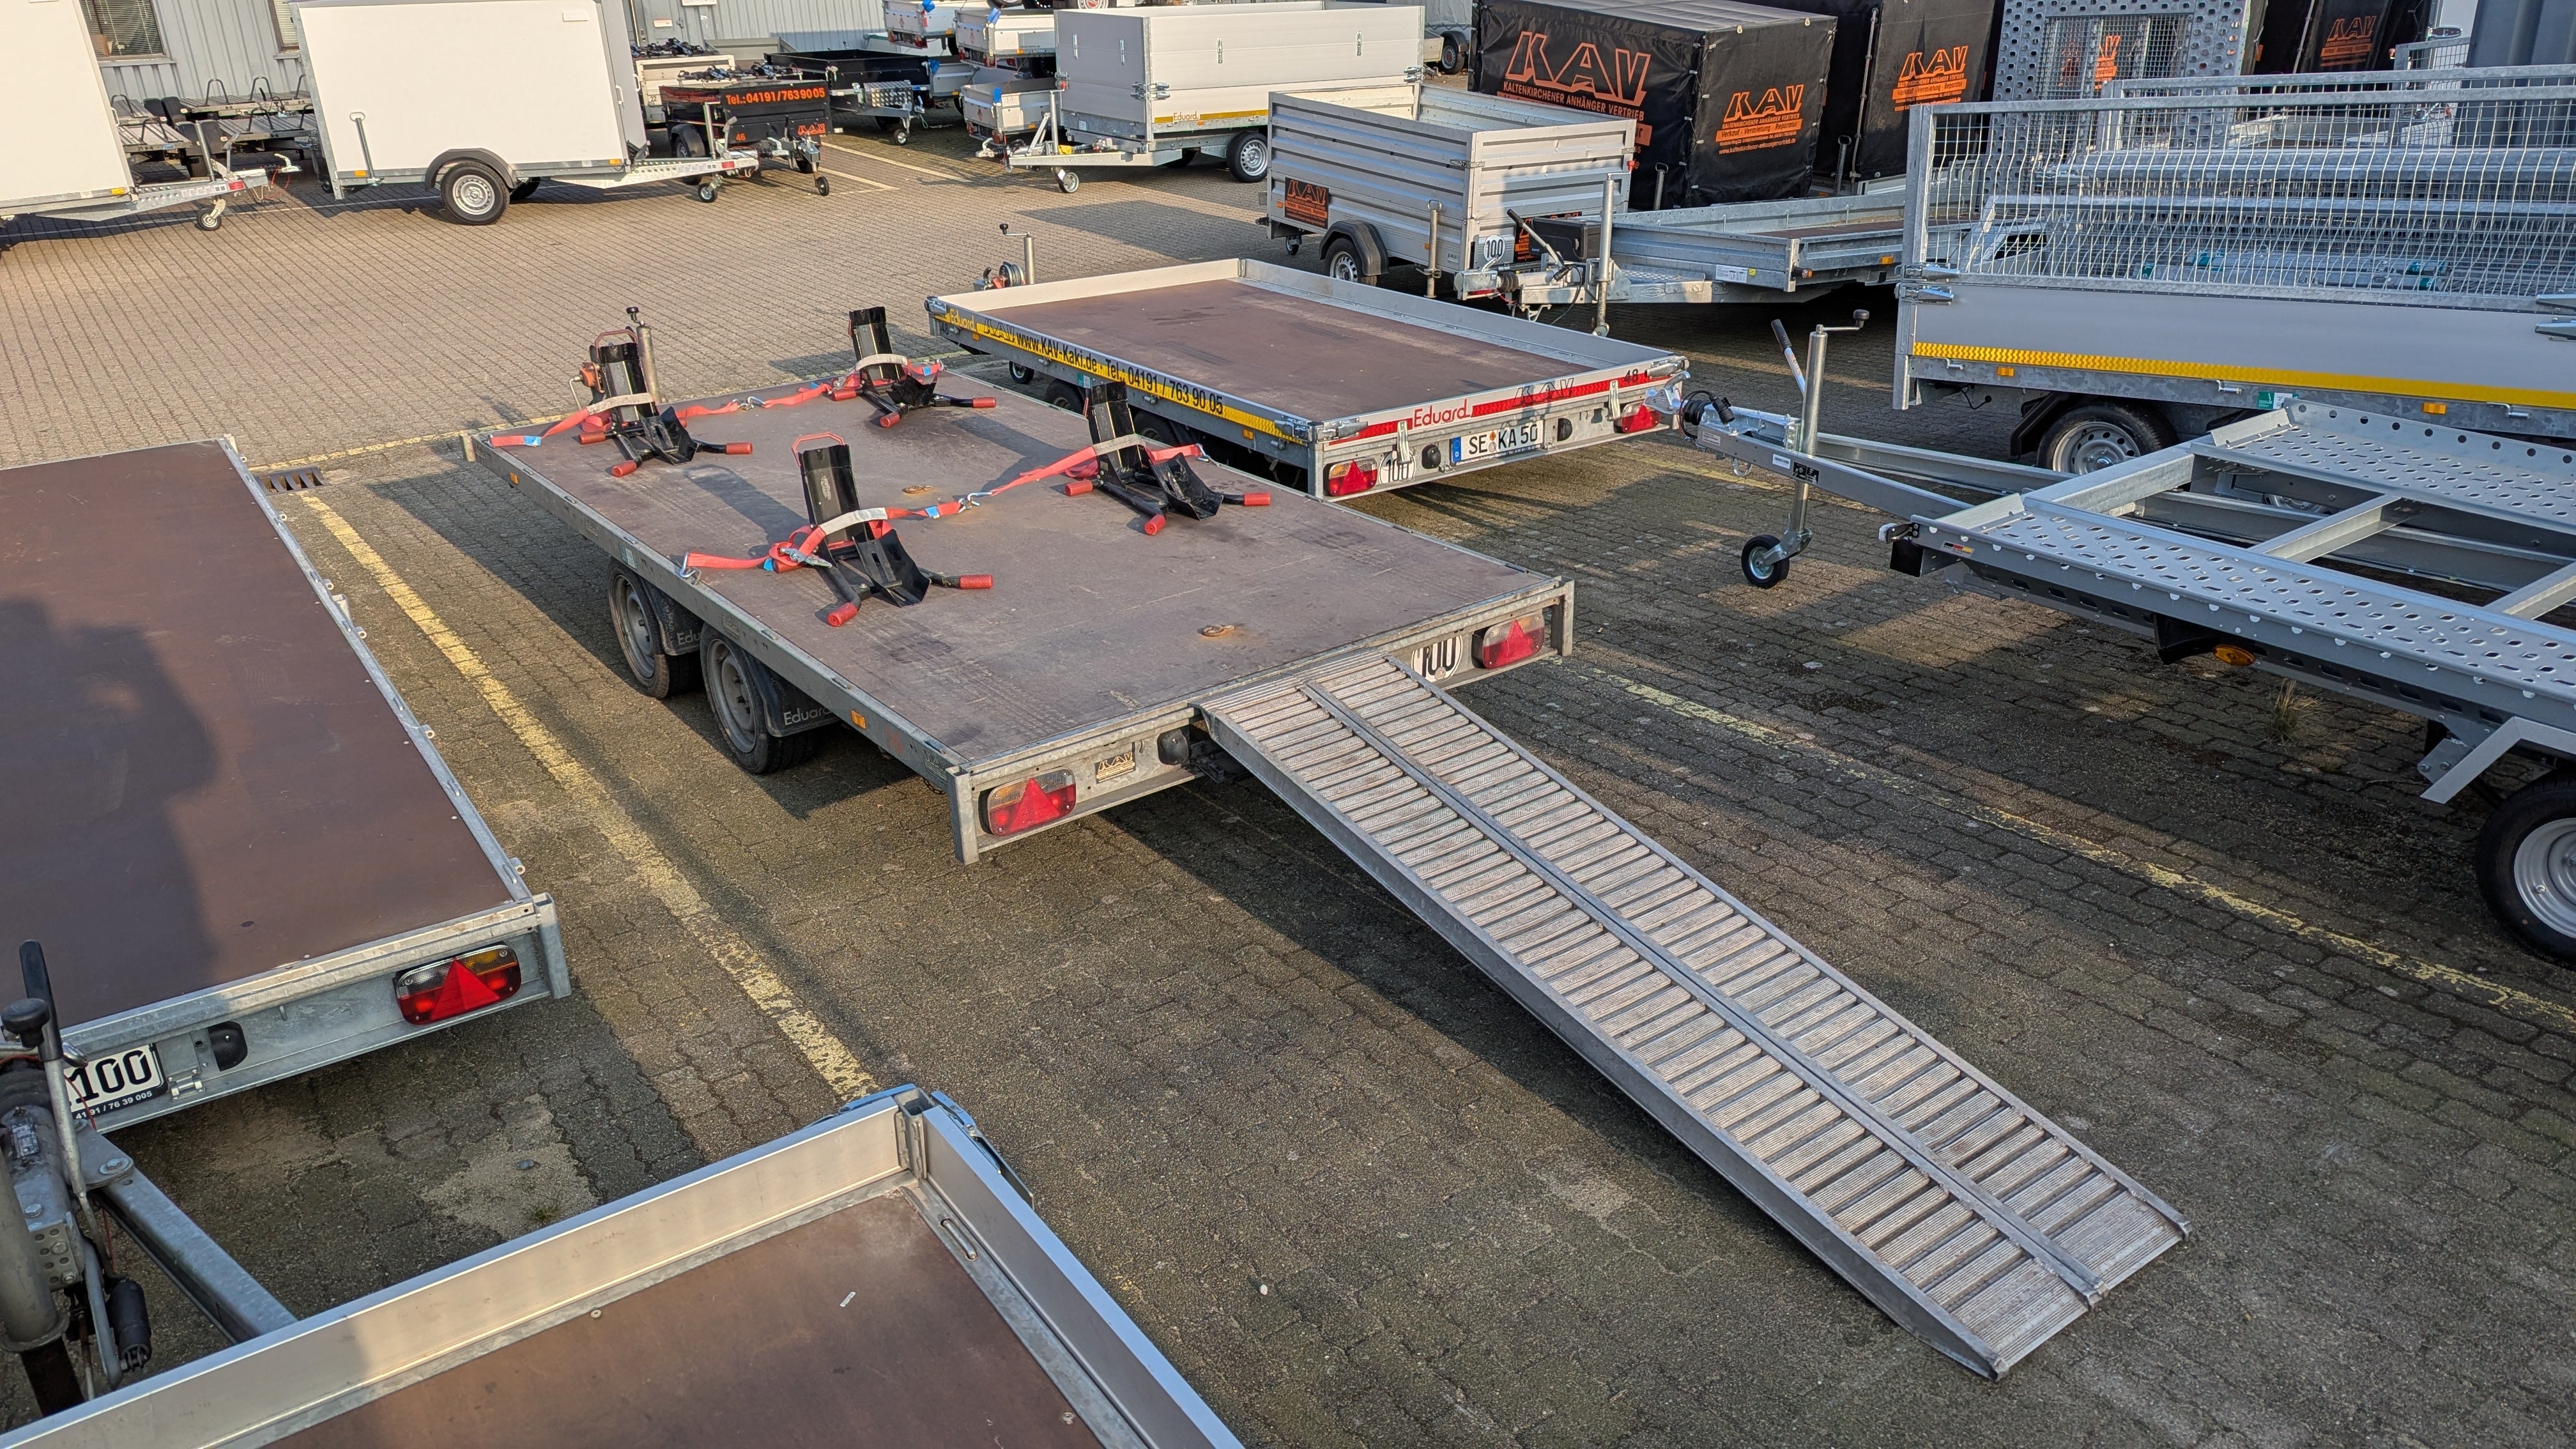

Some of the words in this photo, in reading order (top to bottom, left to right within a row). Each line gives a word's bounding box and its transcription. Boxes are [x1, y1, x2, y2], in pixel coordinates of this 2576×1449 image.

[1505, 31, 1651, 107] KAV
[1899, 45, 1968, 81] KAV
[1503, 81, 1565, 103] KALTENKIRCHENER
[1566, 95, 1606, 113] ANHÄNGER
[1609, 103, 1644, 121] VERTRIEB
[1724, 84, 1804, 123] KAV
[1173, 110, 1199, 121] Eduard
[735, 133, 746, 141] 46
[1287, 180, 1326, 206] KAV
[1487, 238, 1503, 259] 100
[949, 308, 976, 332] Eduard
[983, 318, 1015, 342] KAV
[1016, 332, 1097, 373] www.KAV-Kaki.de
[1105, 358, 1125, 383] Tel.:
[1128, 366, 1157, 393] 04191
[1169, 379, 1189, 403] 763
[1192, 387, 1206, 409] 90
[1209, 392, 1223, 415] 05
[1625, 368, 1639, 383] 48
[1514, 377, 1575, 408] KAV
[1414, 398, 1471, 428] Eduard
[1469, 434, 1488, 455] SE
[1498, 429, 1517, 449] KA
[1521, 424, 1538, 443] 50
[1385, 457, 1409, 483] 100
[1098, 751, 1133, 772] KAV
[90, 1107, 101, 1115] 91
[109, 1101, 121, 1110] 76
[122, 1096, 134, 1105] 39
[135, 1091, 153, 1100] 005
